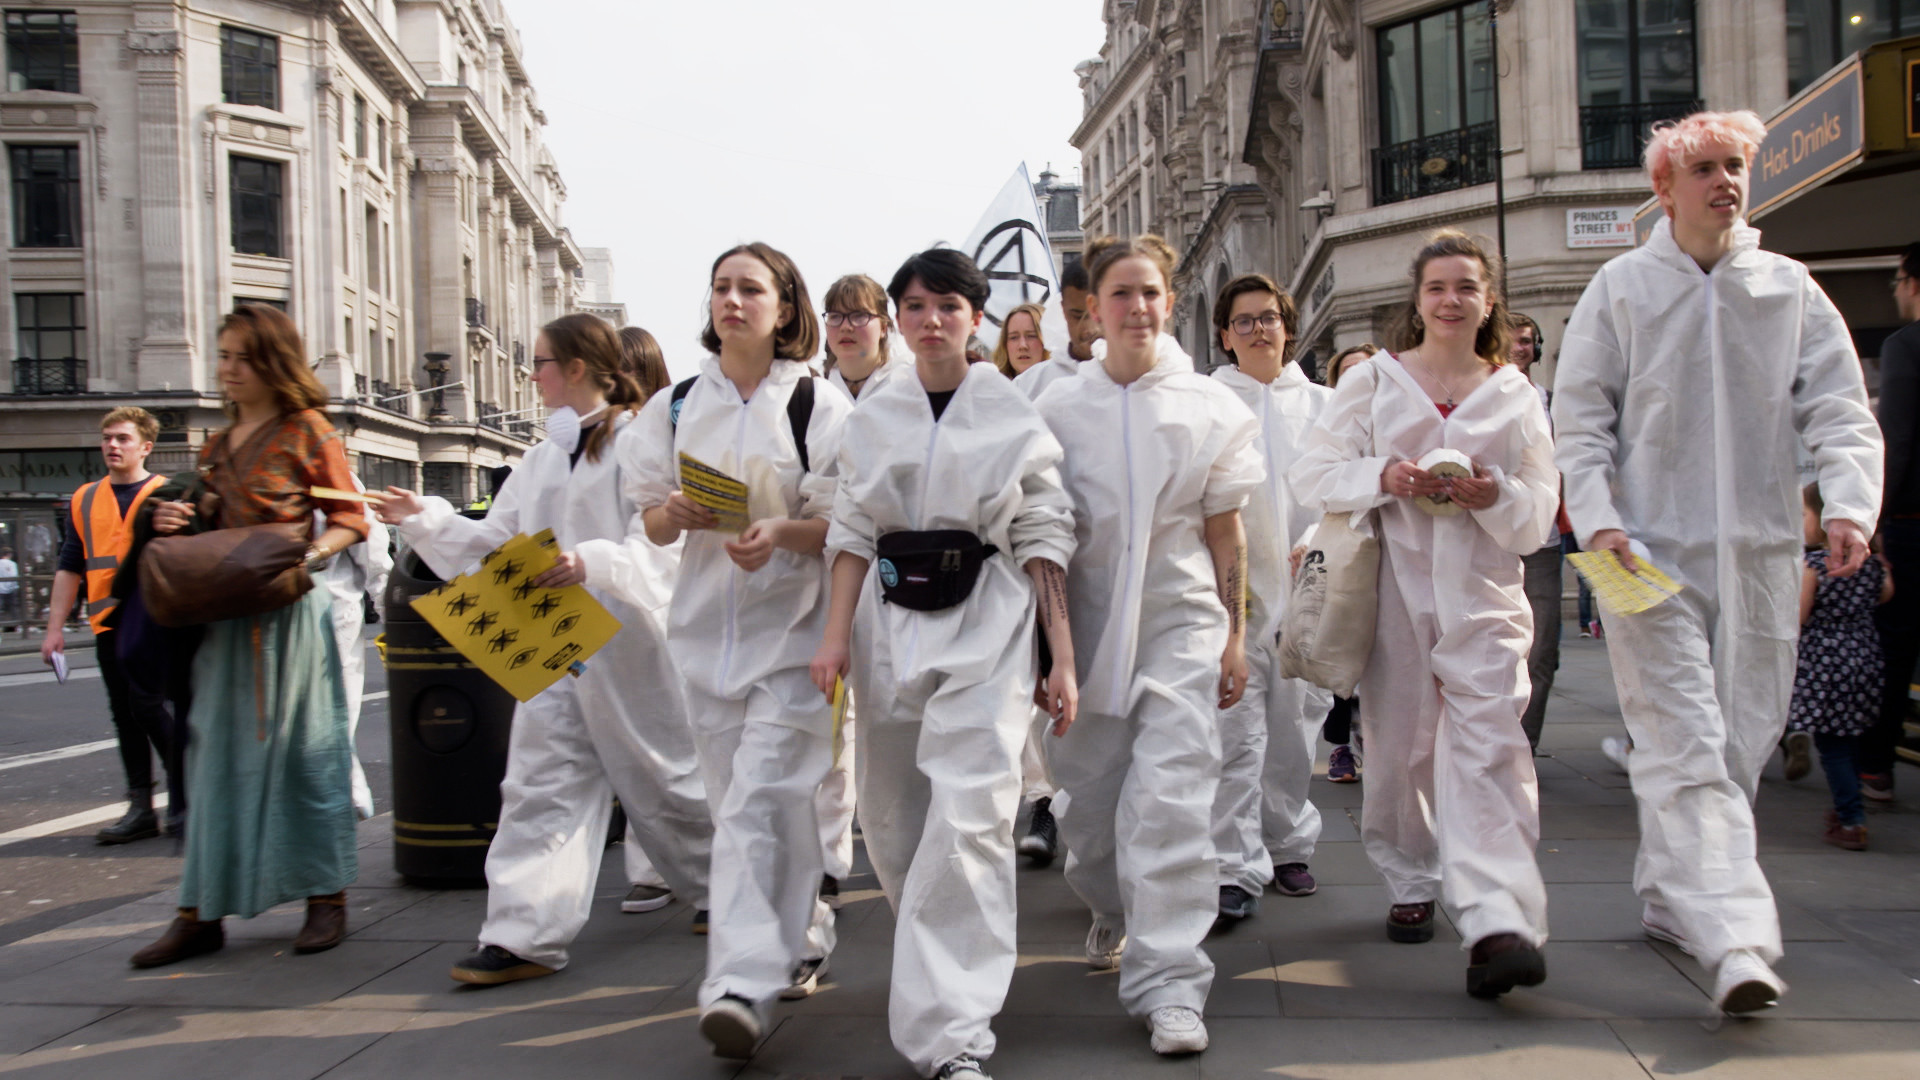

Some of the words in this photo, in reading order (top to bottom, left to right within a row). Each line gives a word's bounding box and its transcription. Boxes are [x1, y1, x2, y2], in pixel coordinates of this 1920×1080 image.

[1762, 147, 1789, 182] Hot
[1792, 111, 1841, 165] Drinks
[1573, 210, 1618, 222] PRINCES
[1574, 222, 1612, 234] STREET
[1616, 223, 1632, 233] W1
